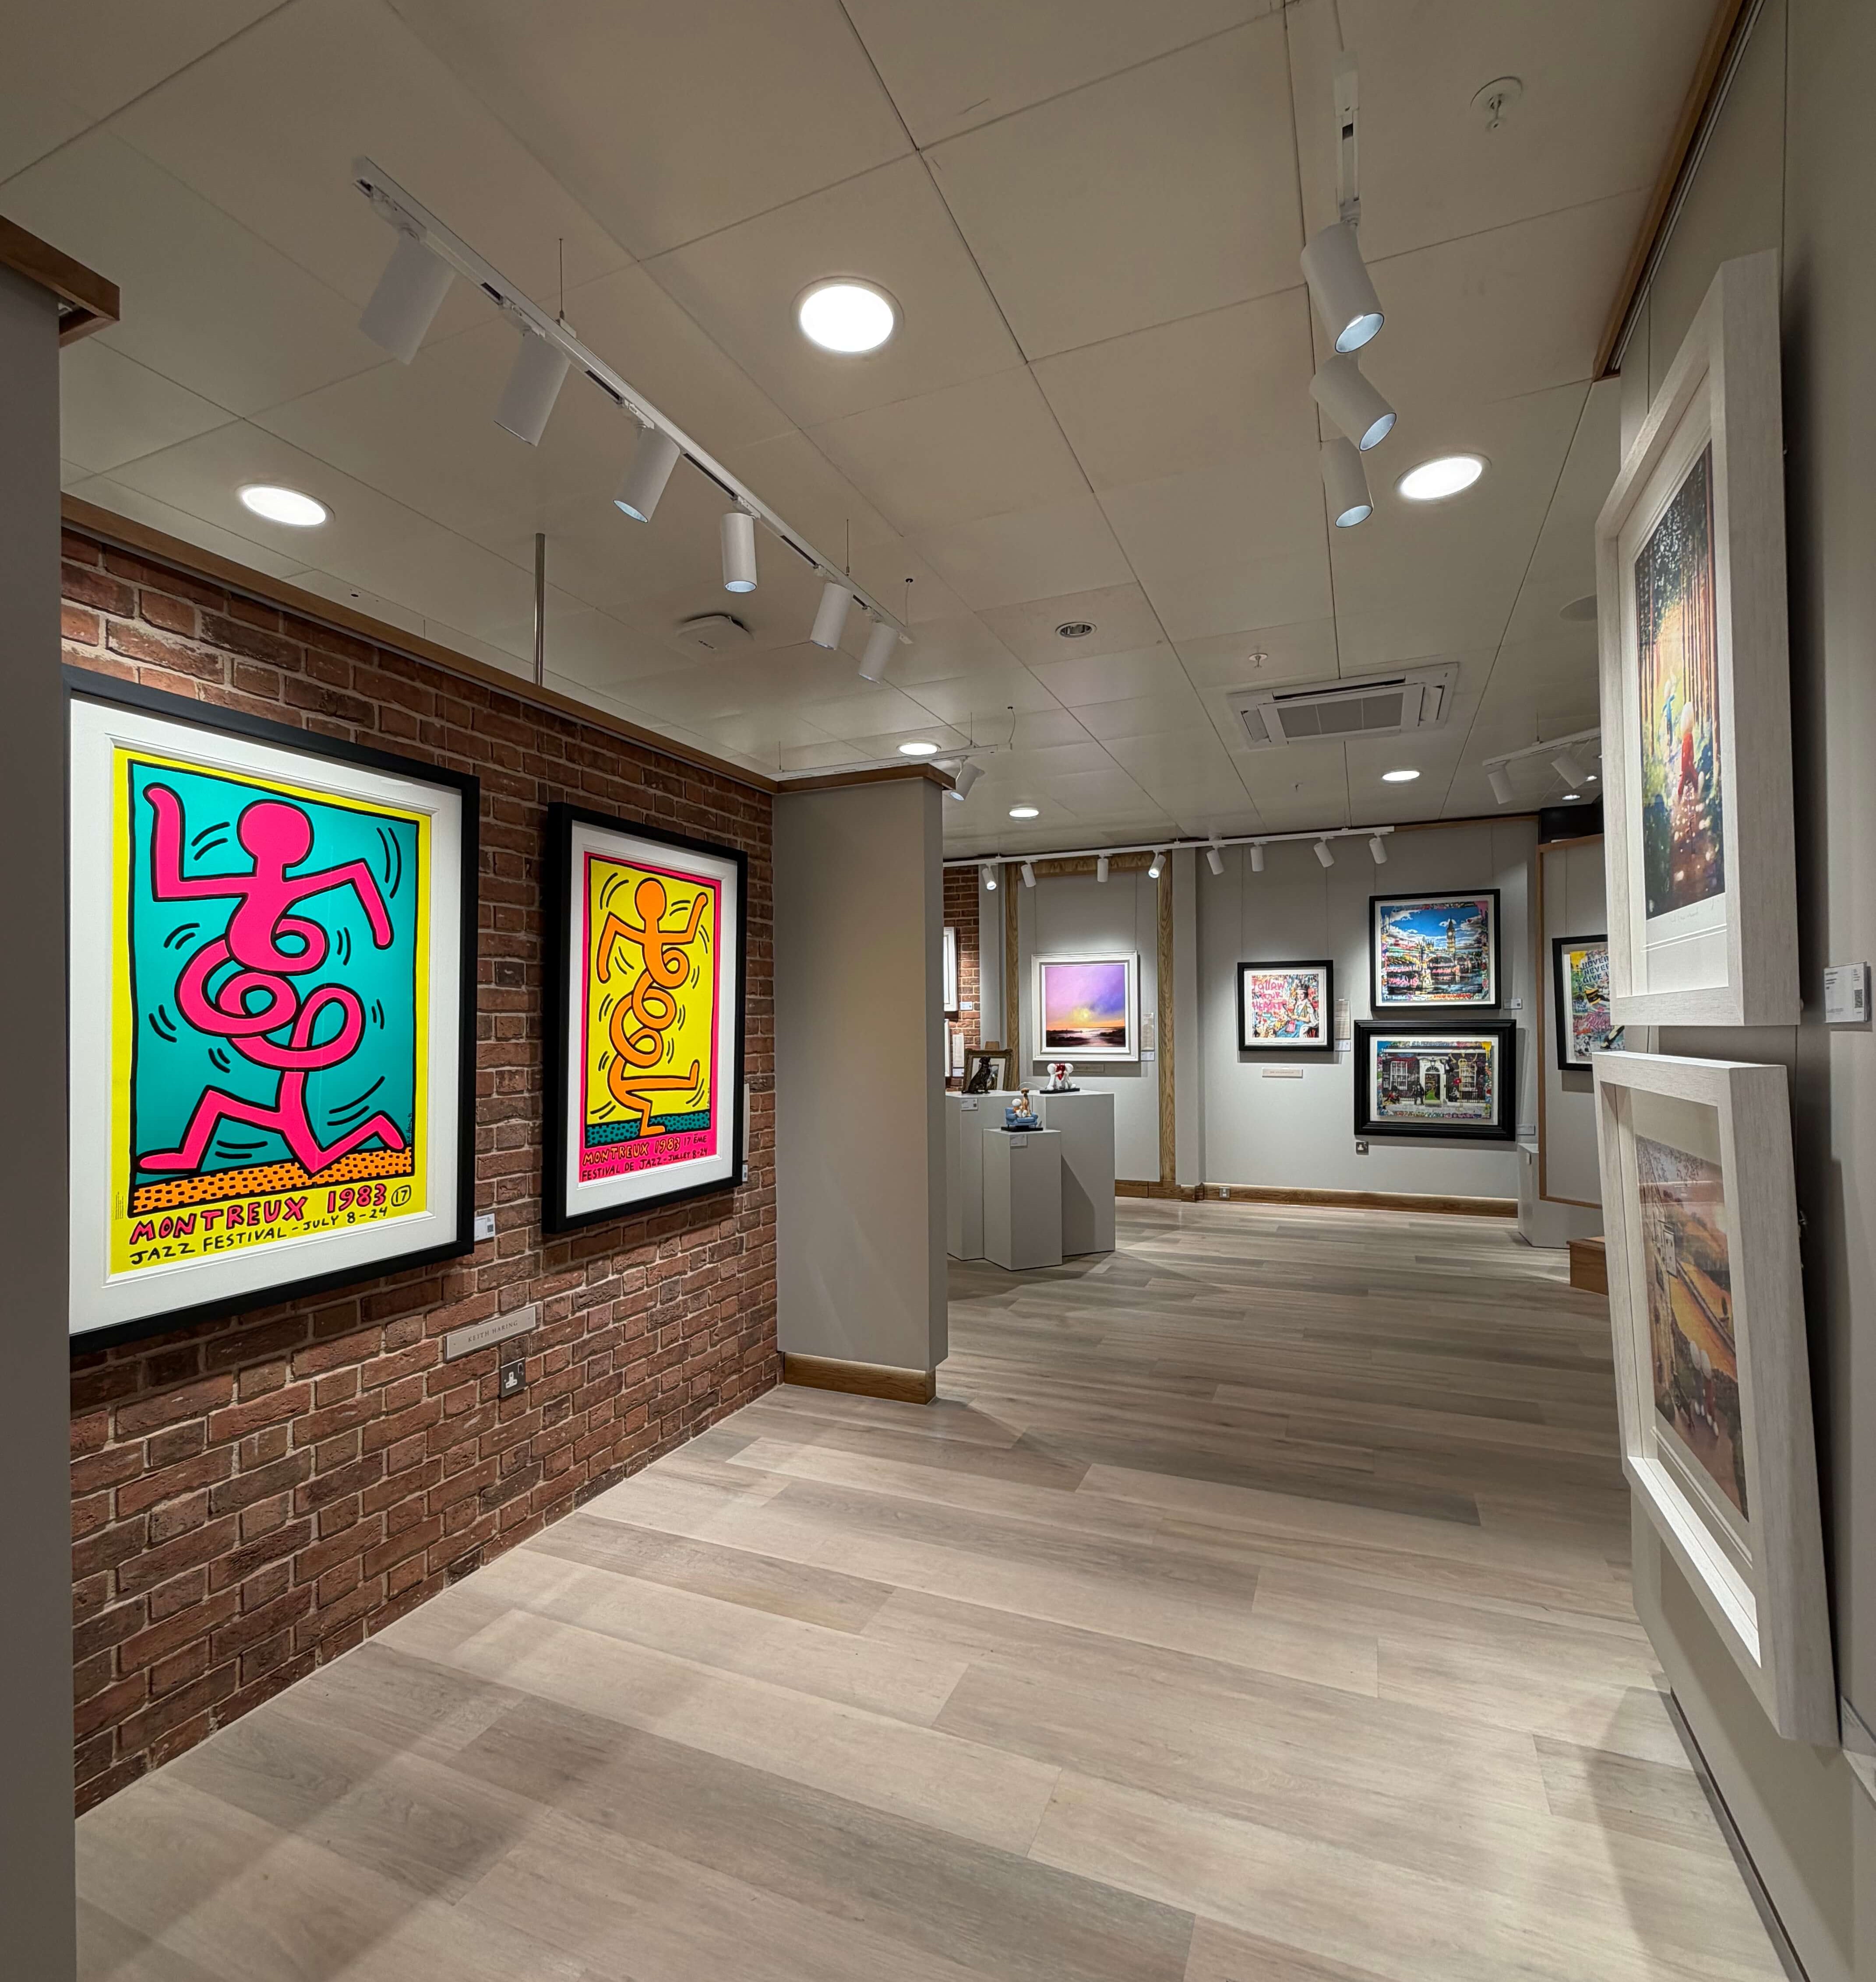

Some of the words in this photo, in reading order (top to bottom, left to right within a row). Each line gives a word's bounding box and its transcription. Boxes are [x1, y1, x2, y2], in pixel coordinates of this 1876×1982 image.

[582, 1142, 649, 1166] MONTREUX
[654, 1137, 680, 1154] 1983
[684, 1136, 691, 1146] 17
[582, 1164, 620, 1182] FESTIVAL
[624, 1161, 634, 1171] DE
[639, 1157, 663, 1170] JAZZ
[130, 1196, 308, 1245] MONTREUX
[327, 1183, 387, 1213] 1983
[395, 1188, 408, 1204] 17
[130, 1243, 195, 1265] JAZZ
[203, 1227, 287, 1252] FESTIVAL
[303, 1215, 339, 1231] JULY
[468, 1330, 489, 1343] KEITH
[492, 1320, 518, 1334] HARING
